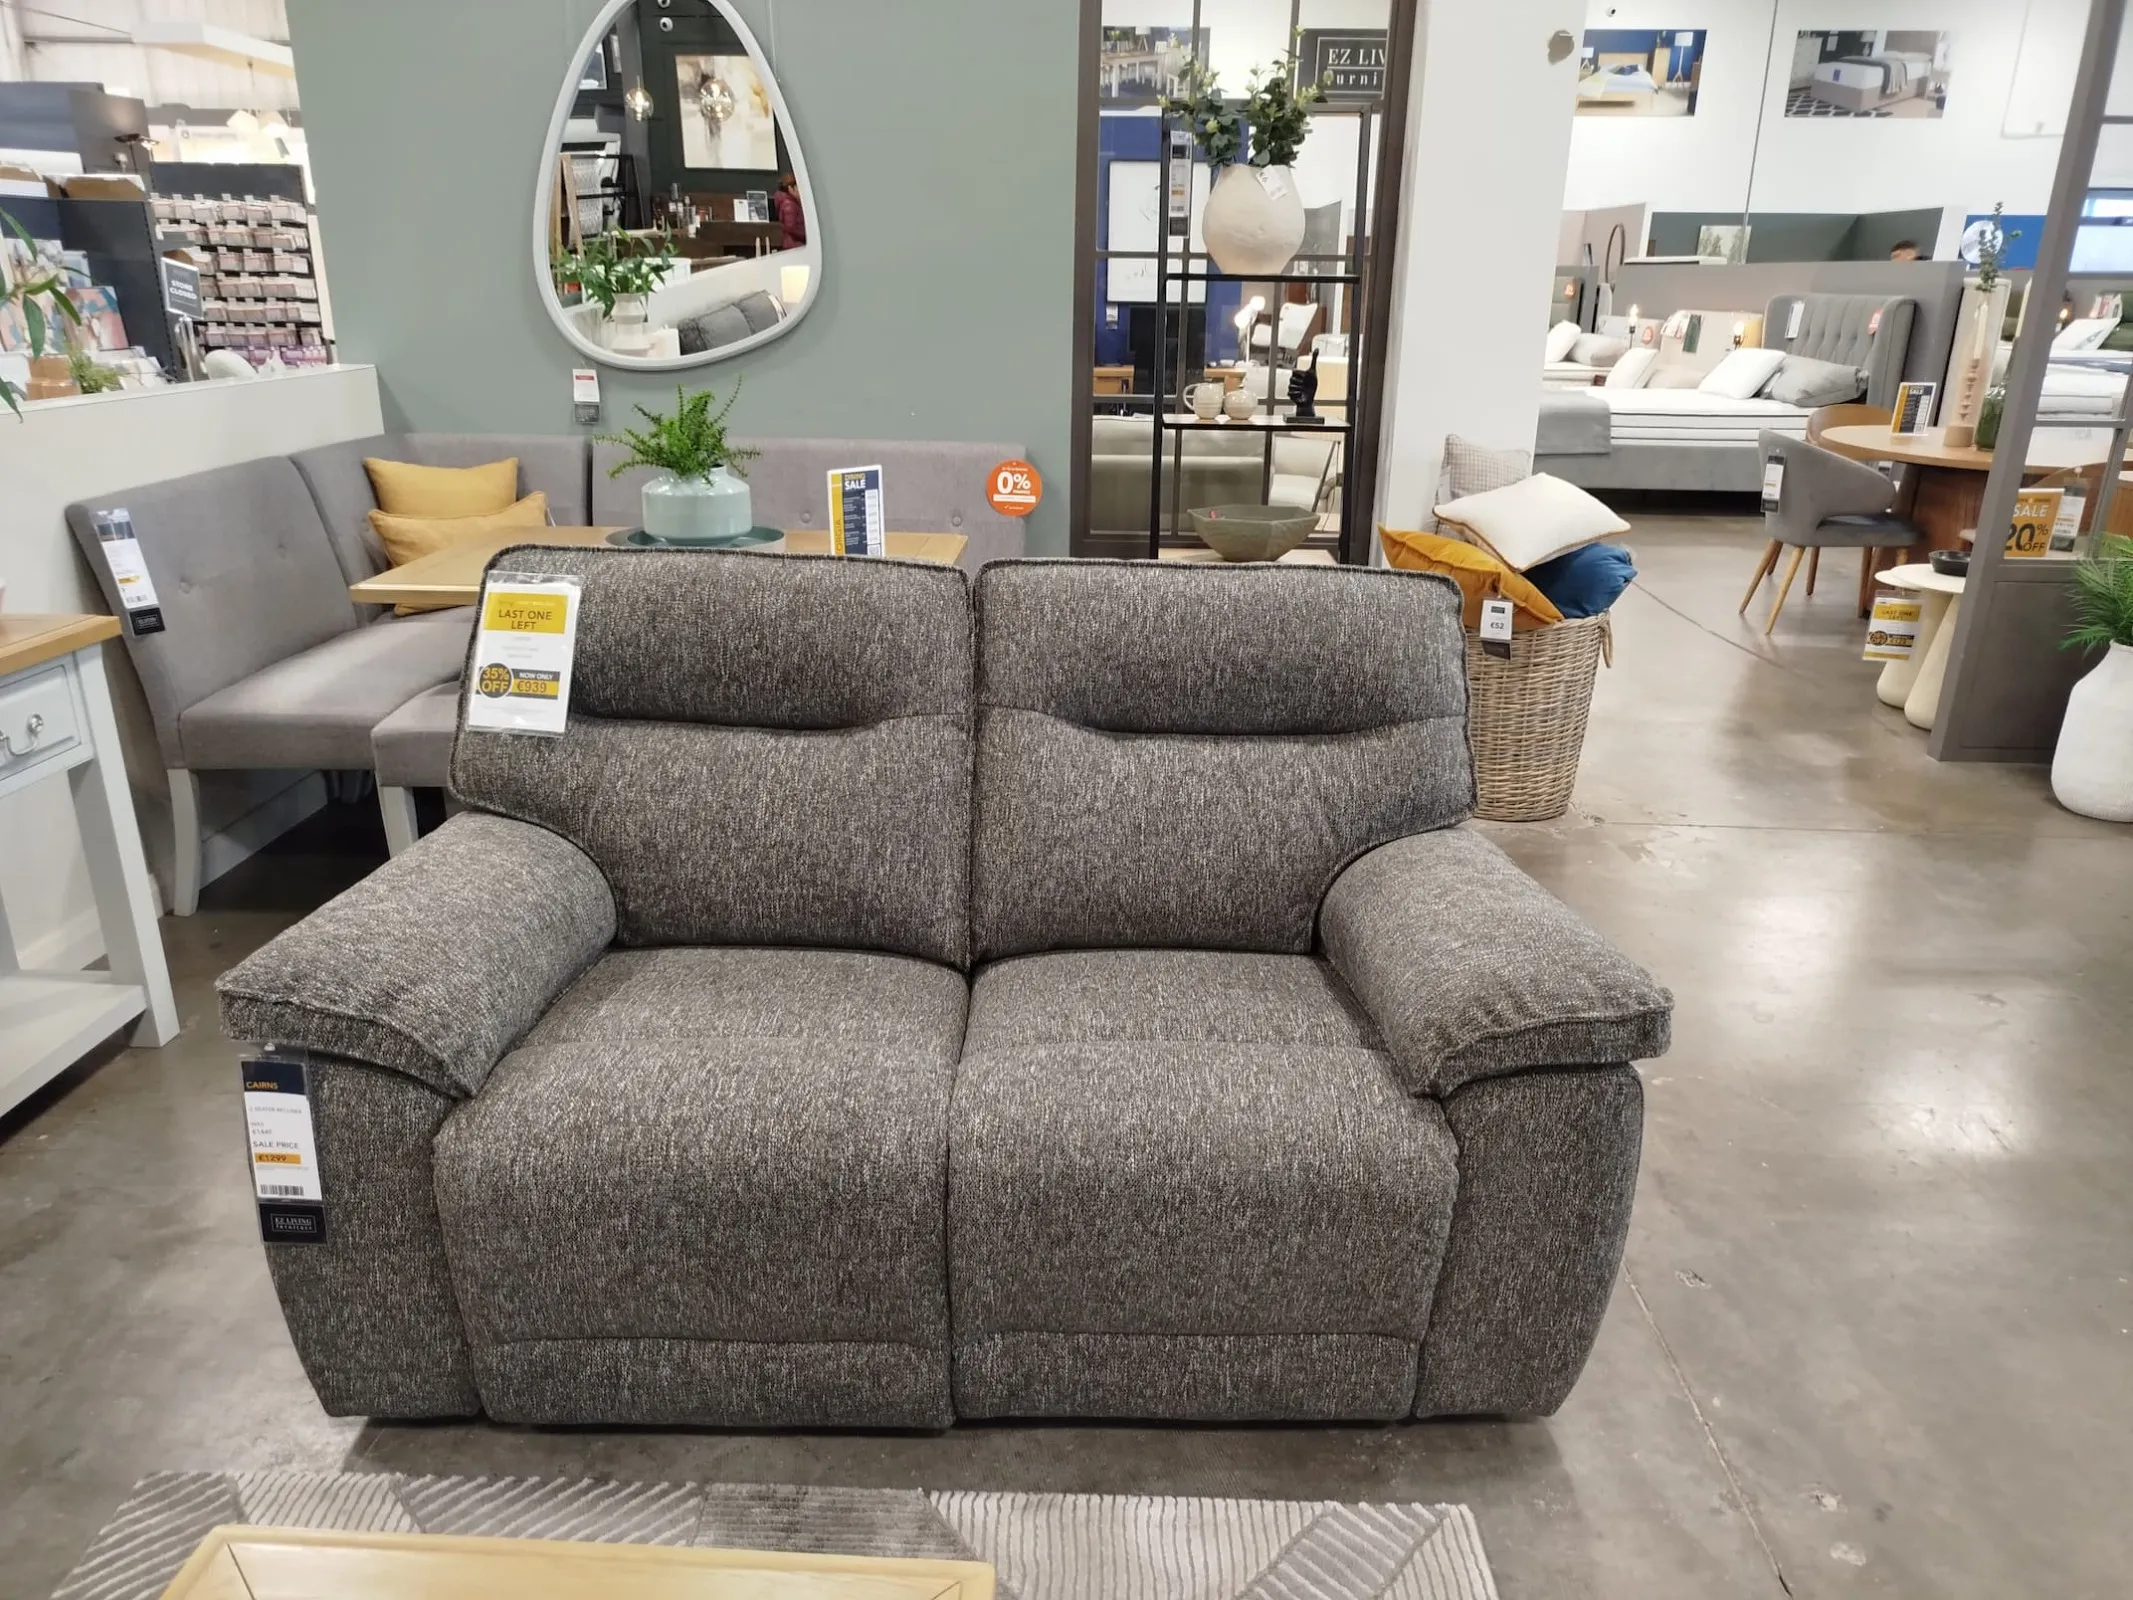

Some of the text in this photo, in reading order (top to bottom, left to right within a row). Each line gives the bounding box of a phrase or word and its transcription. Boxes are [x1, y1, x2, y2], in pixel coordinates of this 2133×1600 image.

[1328, 48, 1351, 65] EZ
[844, 480, 866, 491] SALE
[997, 471, 1031, 493] 0%
[2013, 504, 2048, 517] SALE
[498, 609, 552, 621] LAST ONE
[511, 621, 536, 631] LEFT
[483, 667, 510, 681] 35%
[482, 680, 509, 693] OFF
[517, 680, 547, 693] €939
[246, 1081, 278, 1090] CAIRNS
[253, 1140, 299, 1150] SALE PRICE
